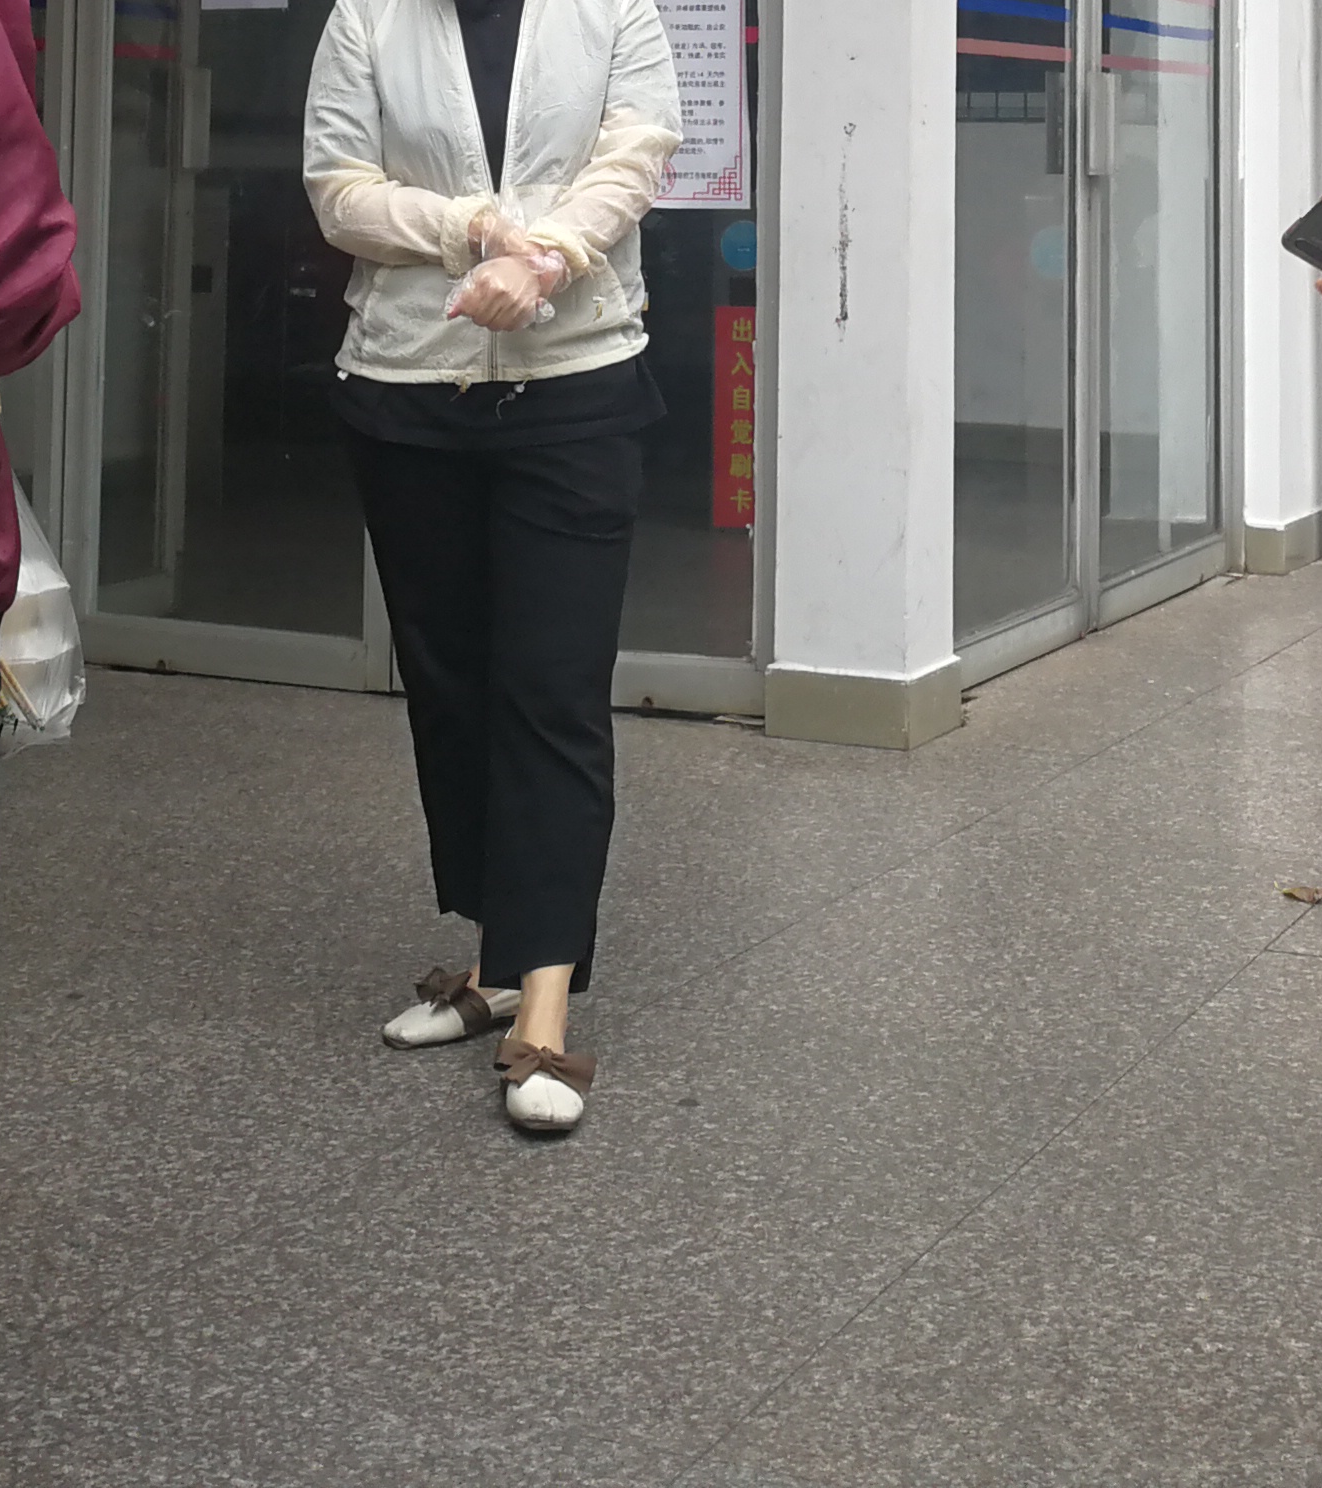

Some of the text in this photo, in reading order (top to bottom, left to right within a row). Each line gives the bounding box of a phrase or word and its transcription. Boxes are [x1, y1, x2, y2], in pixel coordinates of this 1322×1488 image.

[730, 317, 753, 513] 出入自觉刷卡
